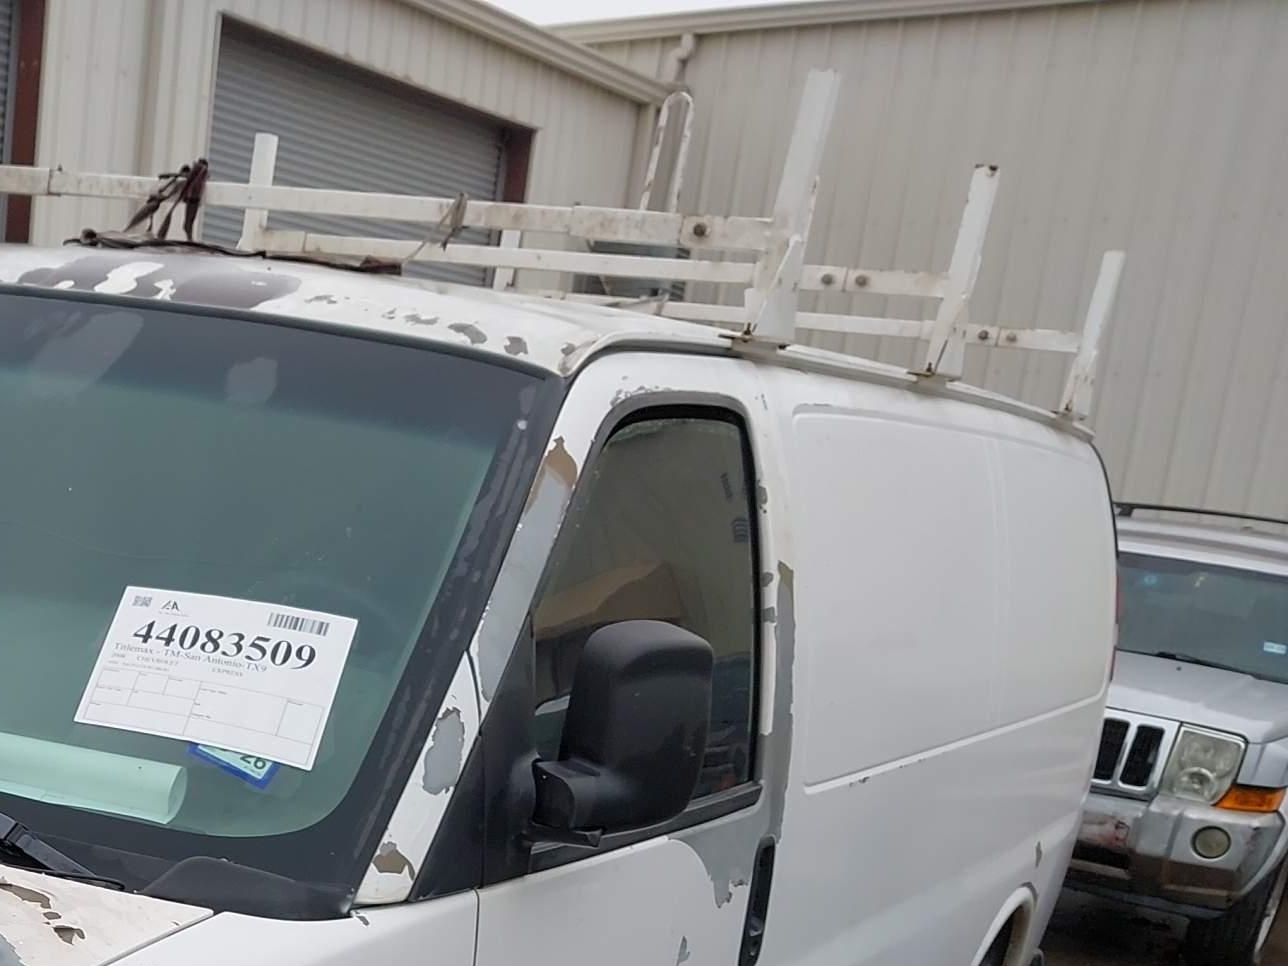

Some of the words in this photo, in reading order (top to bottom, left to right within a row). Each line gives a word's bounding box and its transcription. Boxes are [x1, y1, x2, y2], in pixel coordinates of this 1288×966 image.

[114, 643, 153, 656] Titlemax
[164, 649, 201, 662] TM-San
[133, 620, 317, 670] 44083509
